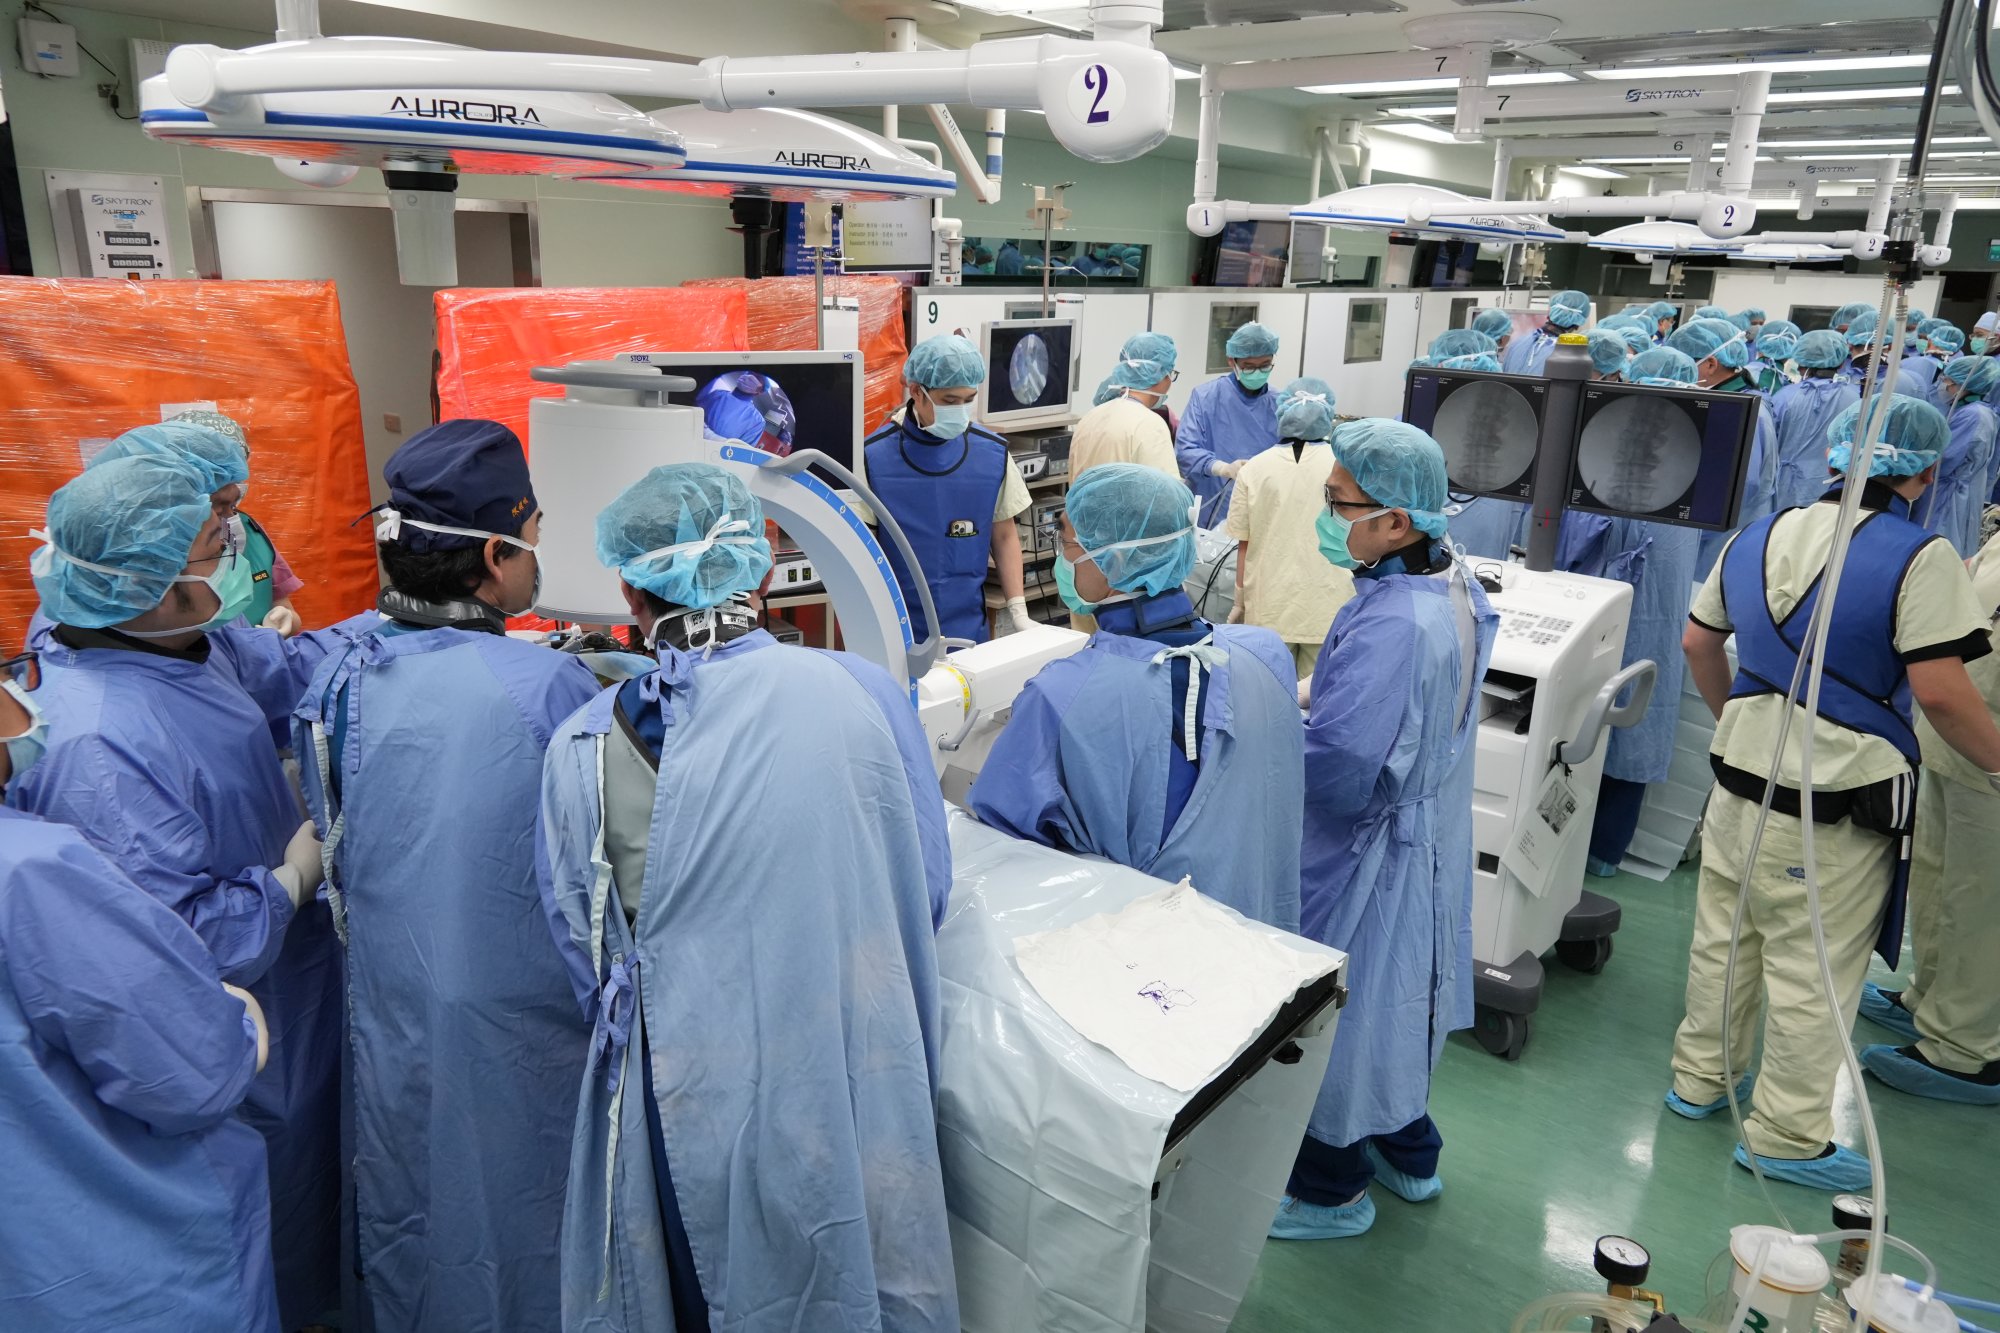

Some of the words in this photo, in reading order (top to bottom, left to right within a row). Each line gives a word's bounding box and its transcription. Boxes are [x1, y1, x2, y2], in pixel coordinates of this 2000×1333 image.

[1435, 57, 1447, 72] 7
[1084, 64, 1110, 124] 2
[1641, 88, 1702, 100] SKYTRON
[1498, 95, 1511, 111] 7
[391, 96, 541, 126] AURORA
[1673, 141, 1684, 152] 6
[775, 150, 871, 172] AURORA
[1787, 180, 1796, 188] 5
[105, 196, 153, 206] SKYTRON
[1821, 198, 1829, 207] 5
[1204, 209, 1209, 226] 1
[1723, 205, 1735, 227] 2
[1869, 238, 1876, 252] 2
[1935, 250, 1942, 260] 2
[928, 301, 939, 324] 9
